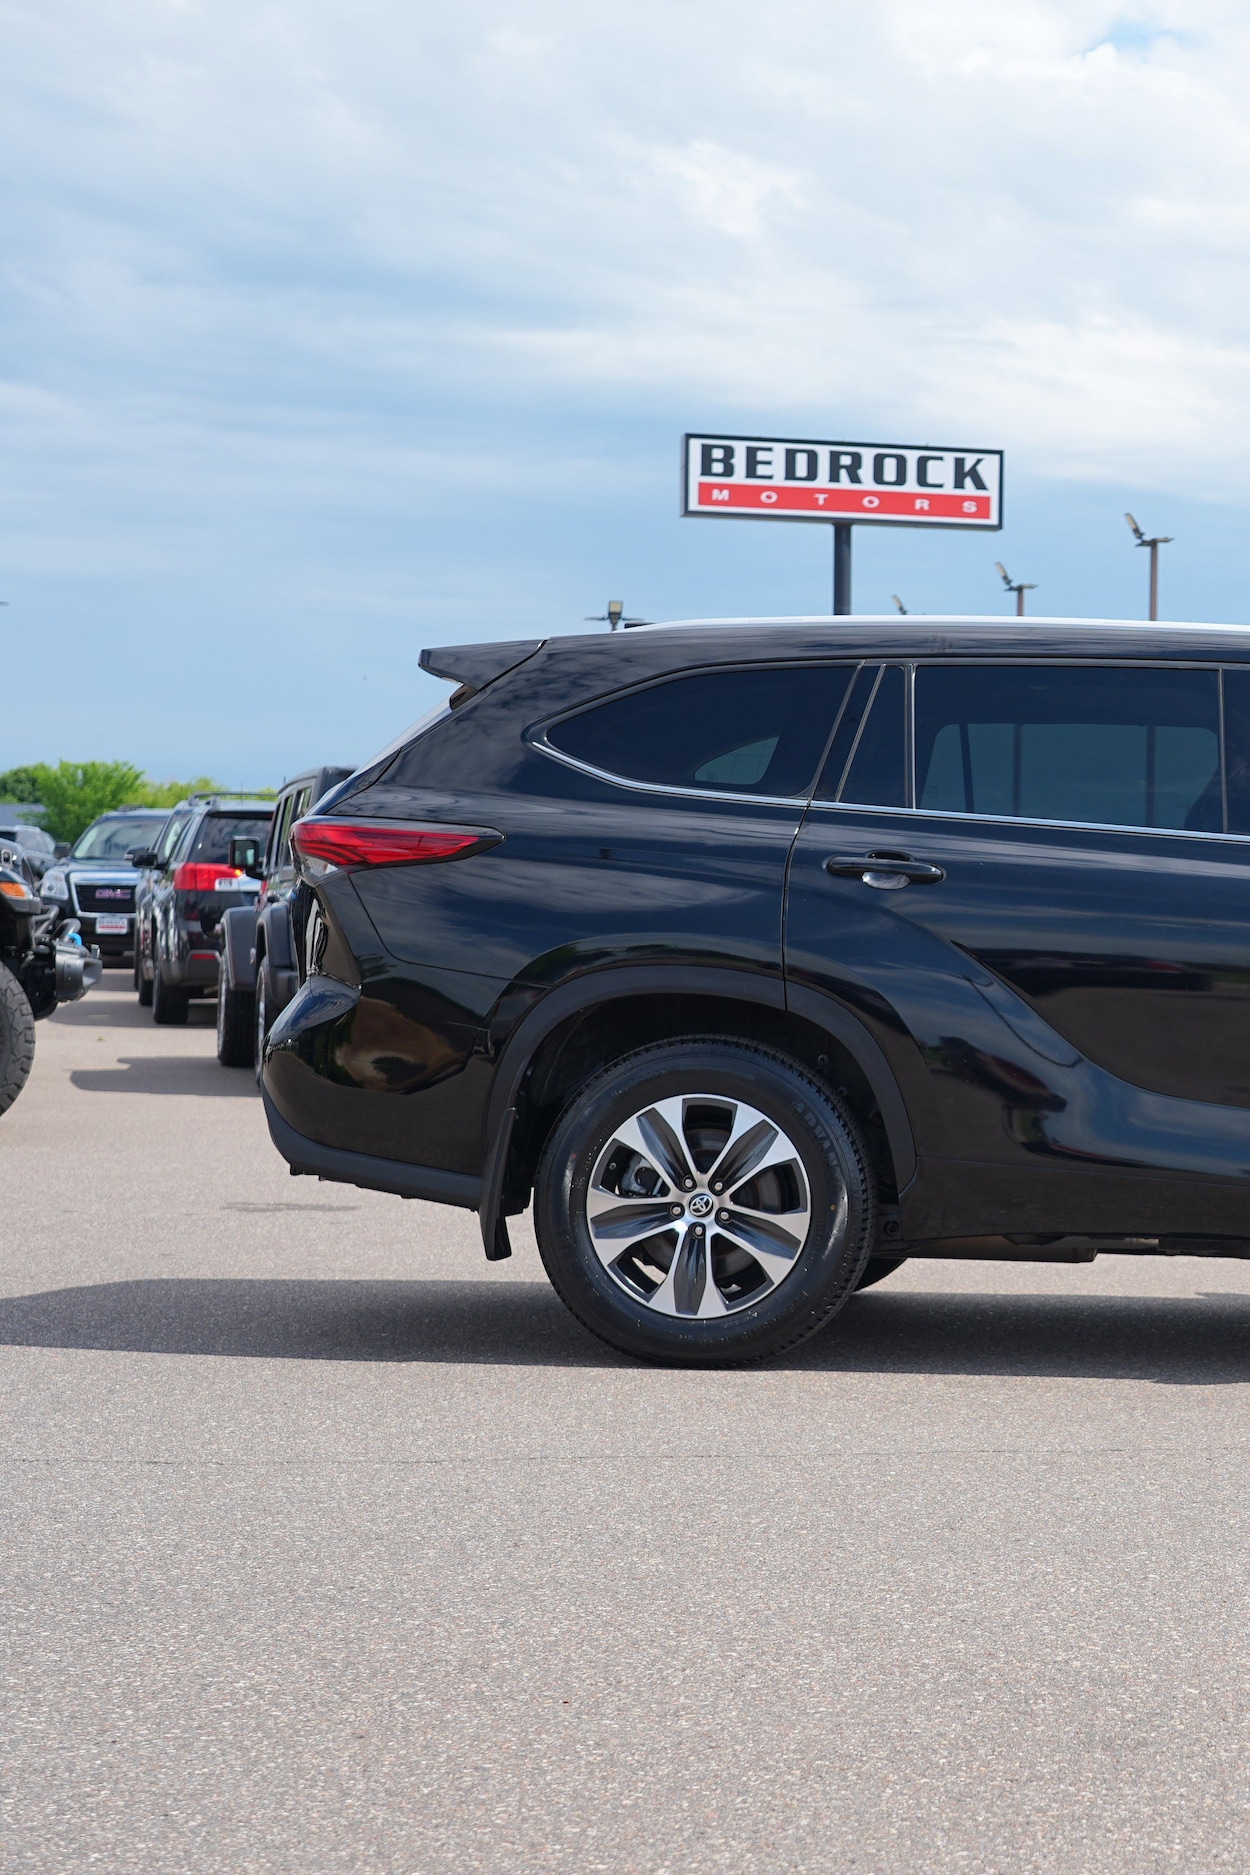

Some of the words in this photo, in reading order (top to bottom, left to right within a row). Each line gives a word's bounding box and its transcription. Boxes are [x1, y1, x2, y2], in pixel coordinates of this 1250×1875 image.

[700, 443, 989, 490] BEDROCK
[712, 488, 978, 513] MOTORS
[95, 888, 131, 900] GMC
